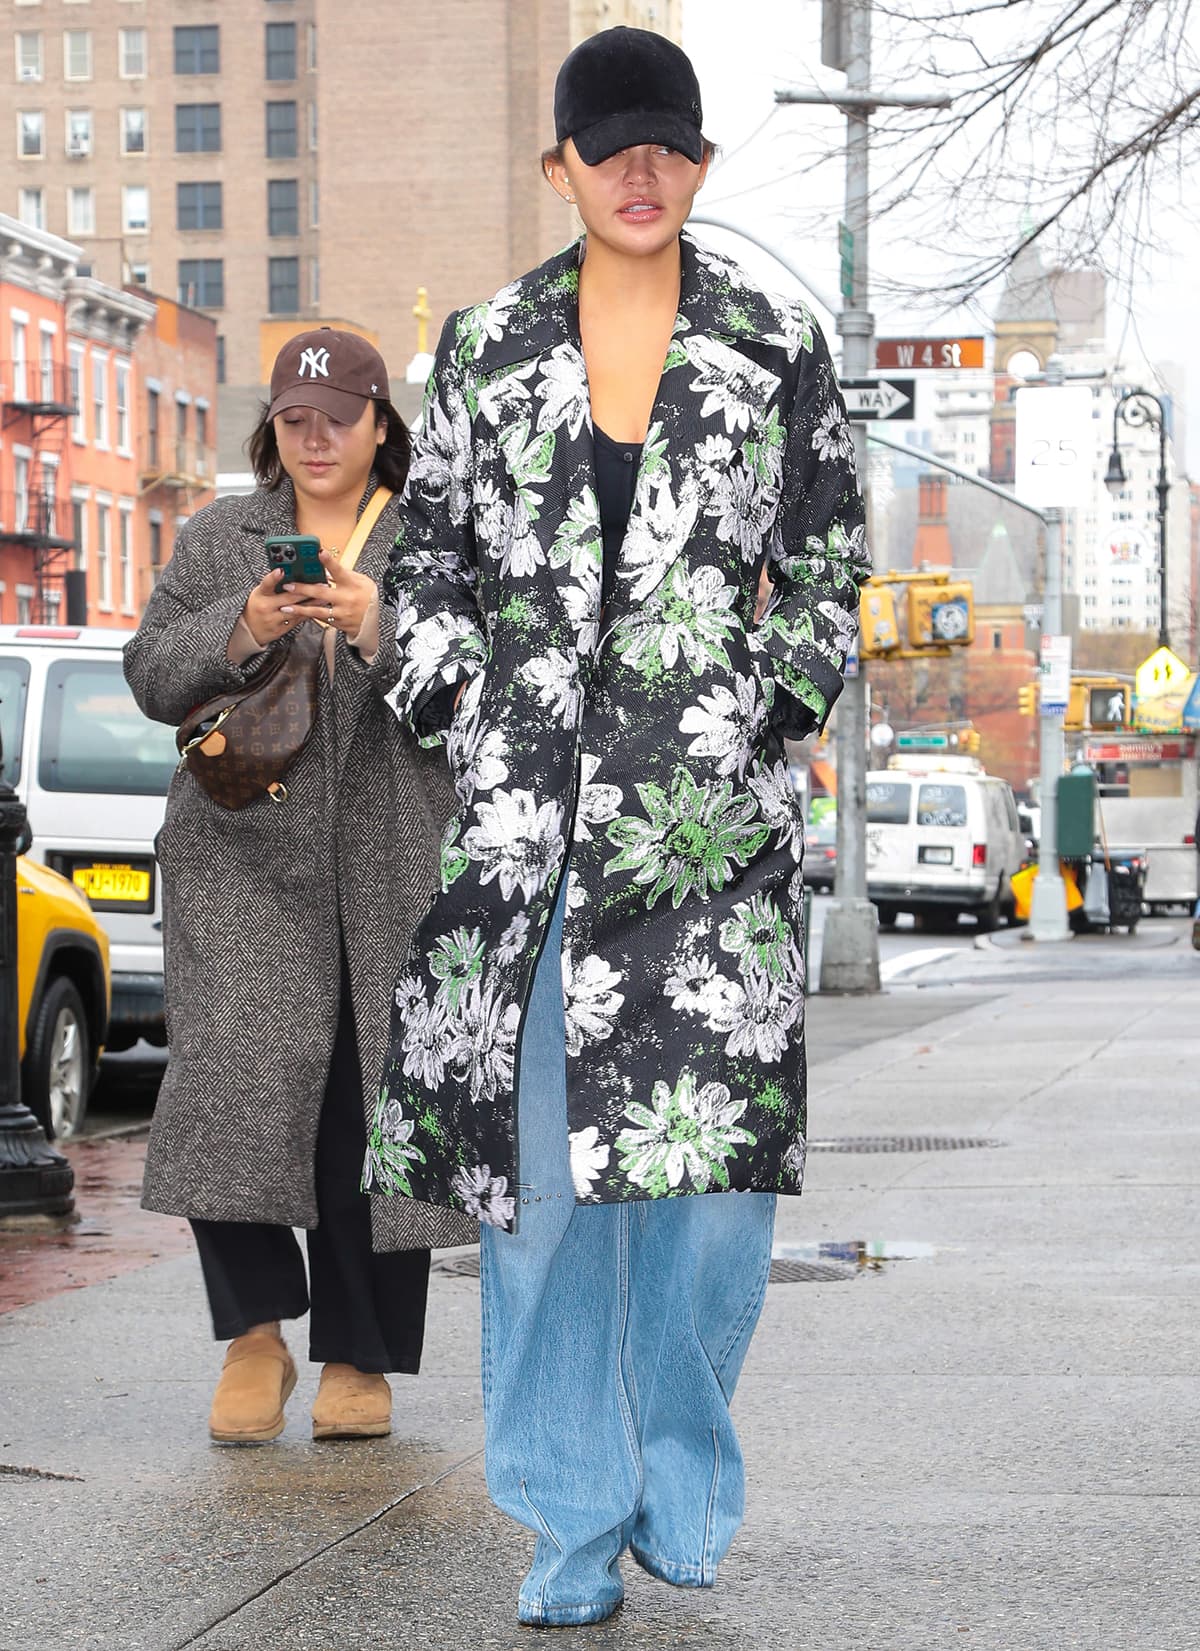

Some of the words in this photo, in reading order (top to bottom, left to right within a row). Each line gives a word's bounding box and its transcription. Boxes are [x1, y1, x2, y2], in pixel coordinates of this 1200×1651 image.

[297, 346, 331, 379] NY
[896, 345, 915, 367] W
[921, 344, 933, 367] 4
[941, 343, 962, 368] St
[858, 391, 896, 407] WAY
[1030, 439, 1078, 467] 25
